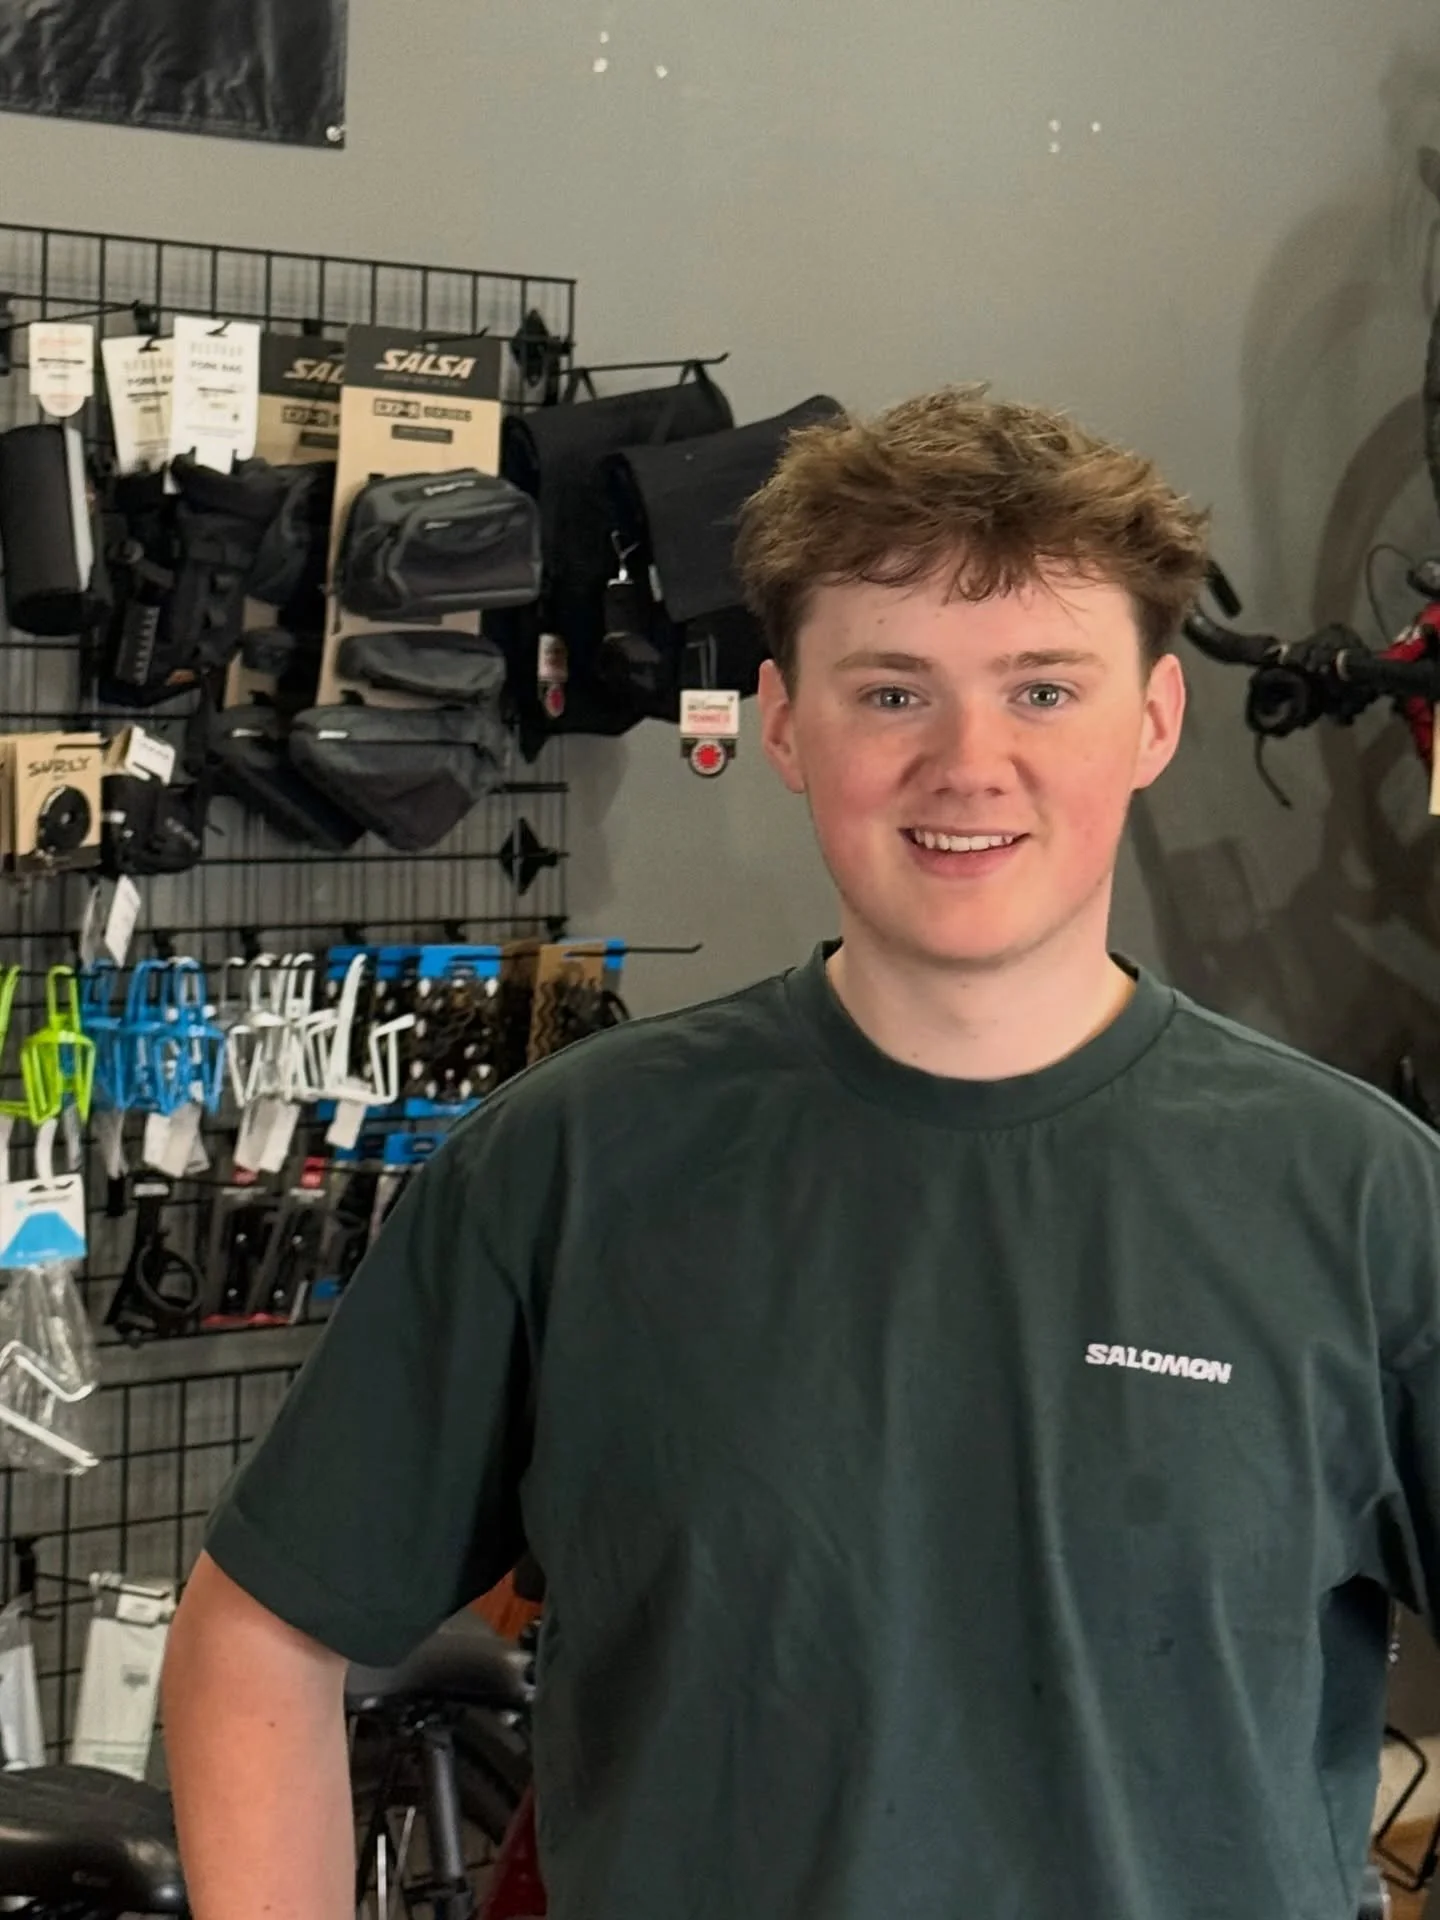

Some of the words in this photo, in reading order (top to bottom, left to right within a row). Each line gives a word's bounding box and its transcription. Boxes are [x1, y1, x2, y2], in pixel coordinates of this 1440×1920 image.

[283, 358, 344, 384] SAL
[375, 350, 478, 381] SALSA
[27, 757, 91, 778] SURLY
[1085, 1343, 1232, 1385] SALOMON
